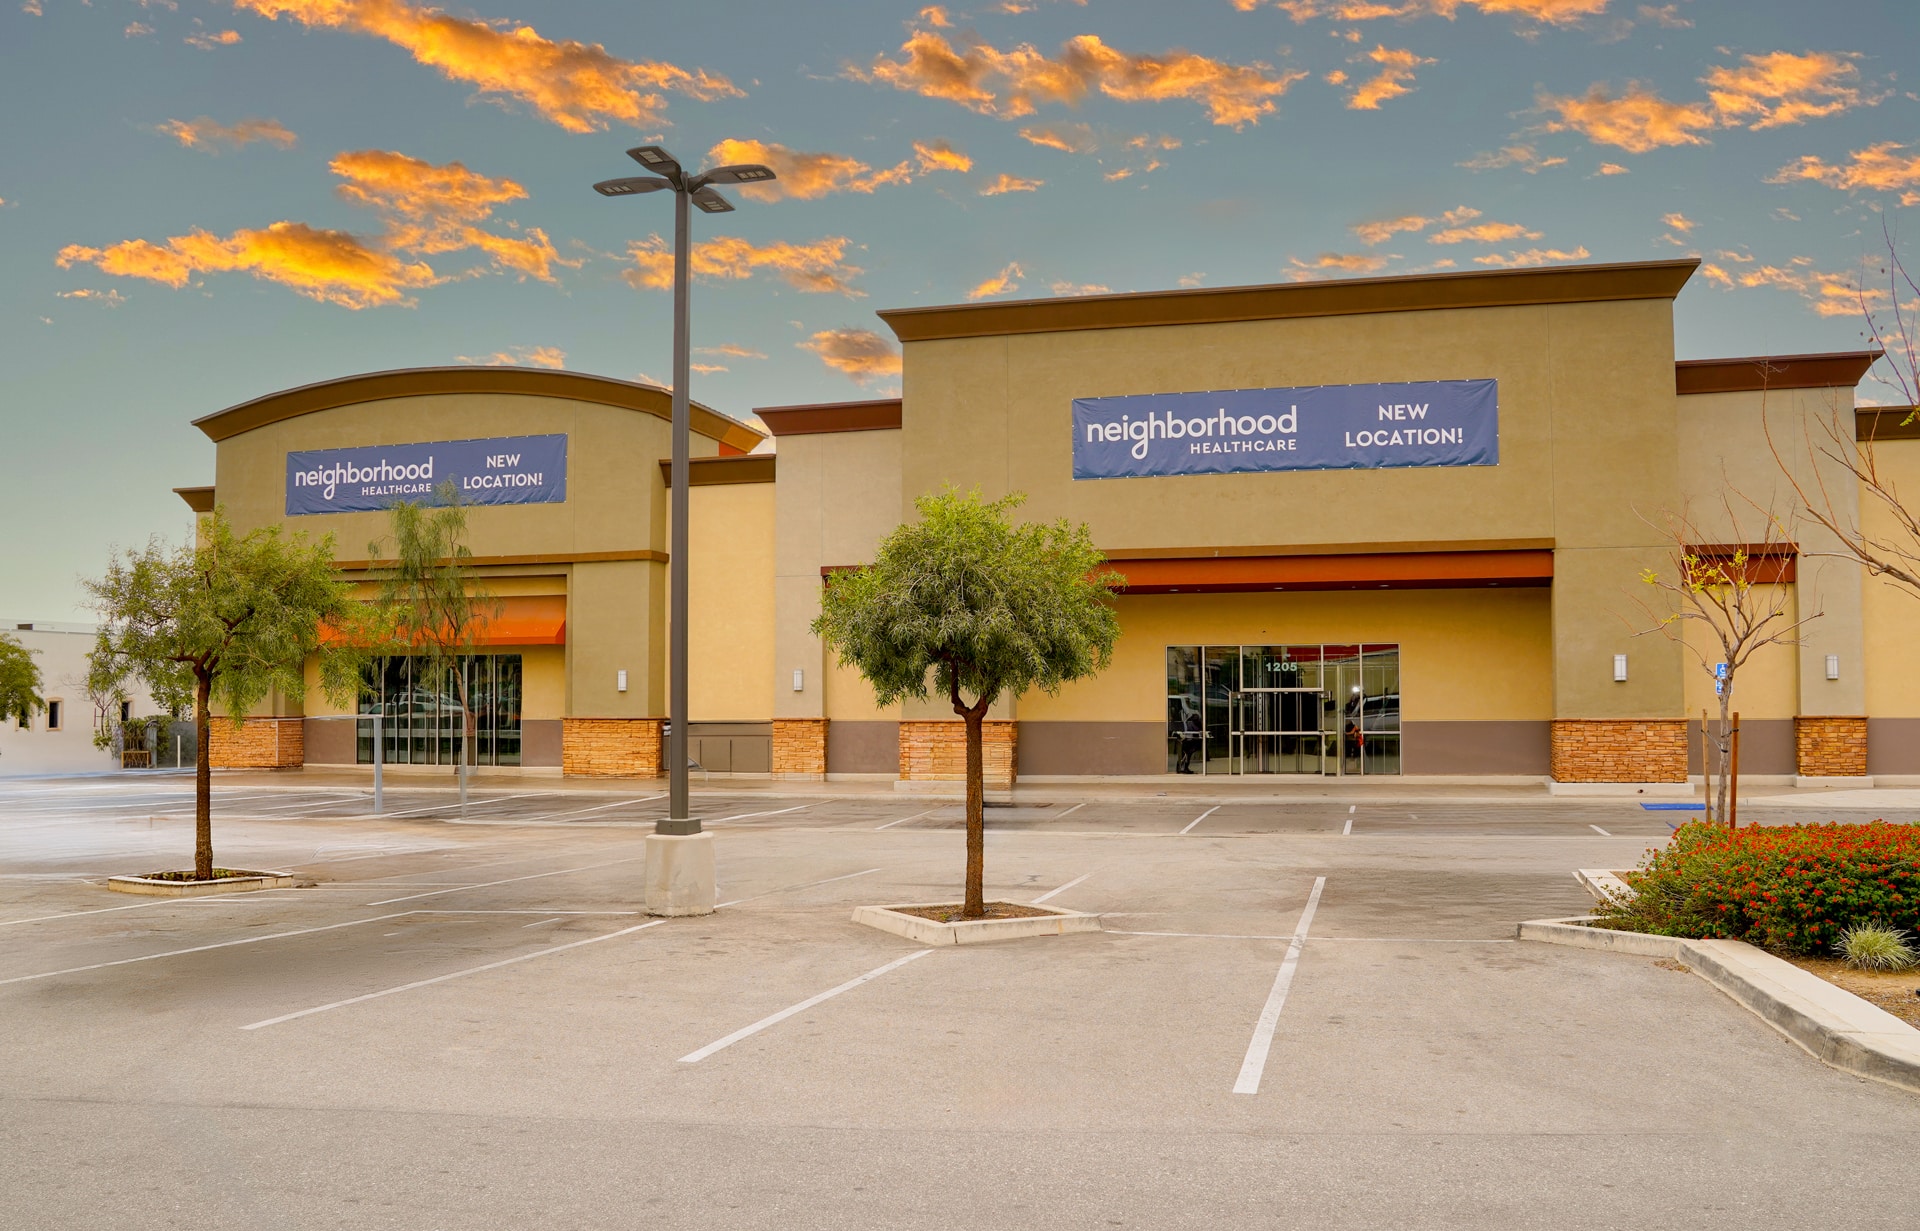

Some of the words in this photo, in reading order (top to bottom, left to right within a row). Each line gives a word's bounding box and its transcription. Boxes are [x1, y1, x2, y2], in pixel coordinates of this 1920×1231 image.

[1378, 403, 1429, 421] NEW
[1087, 405, 1297, 460] neighborhood
[1345, 427, 1464, 448] LOCATION!
[1190, 438, 1297, 455] HEALTHCARE
[486, 453, 521, 469] NEW
[295, 456, 433, 500] neighborhood
[463, 472, 543, 490] LOCATION!
[361, 483, 432, 496] HEALTHCARE
[1265, 662, 1298, 672] 1205
